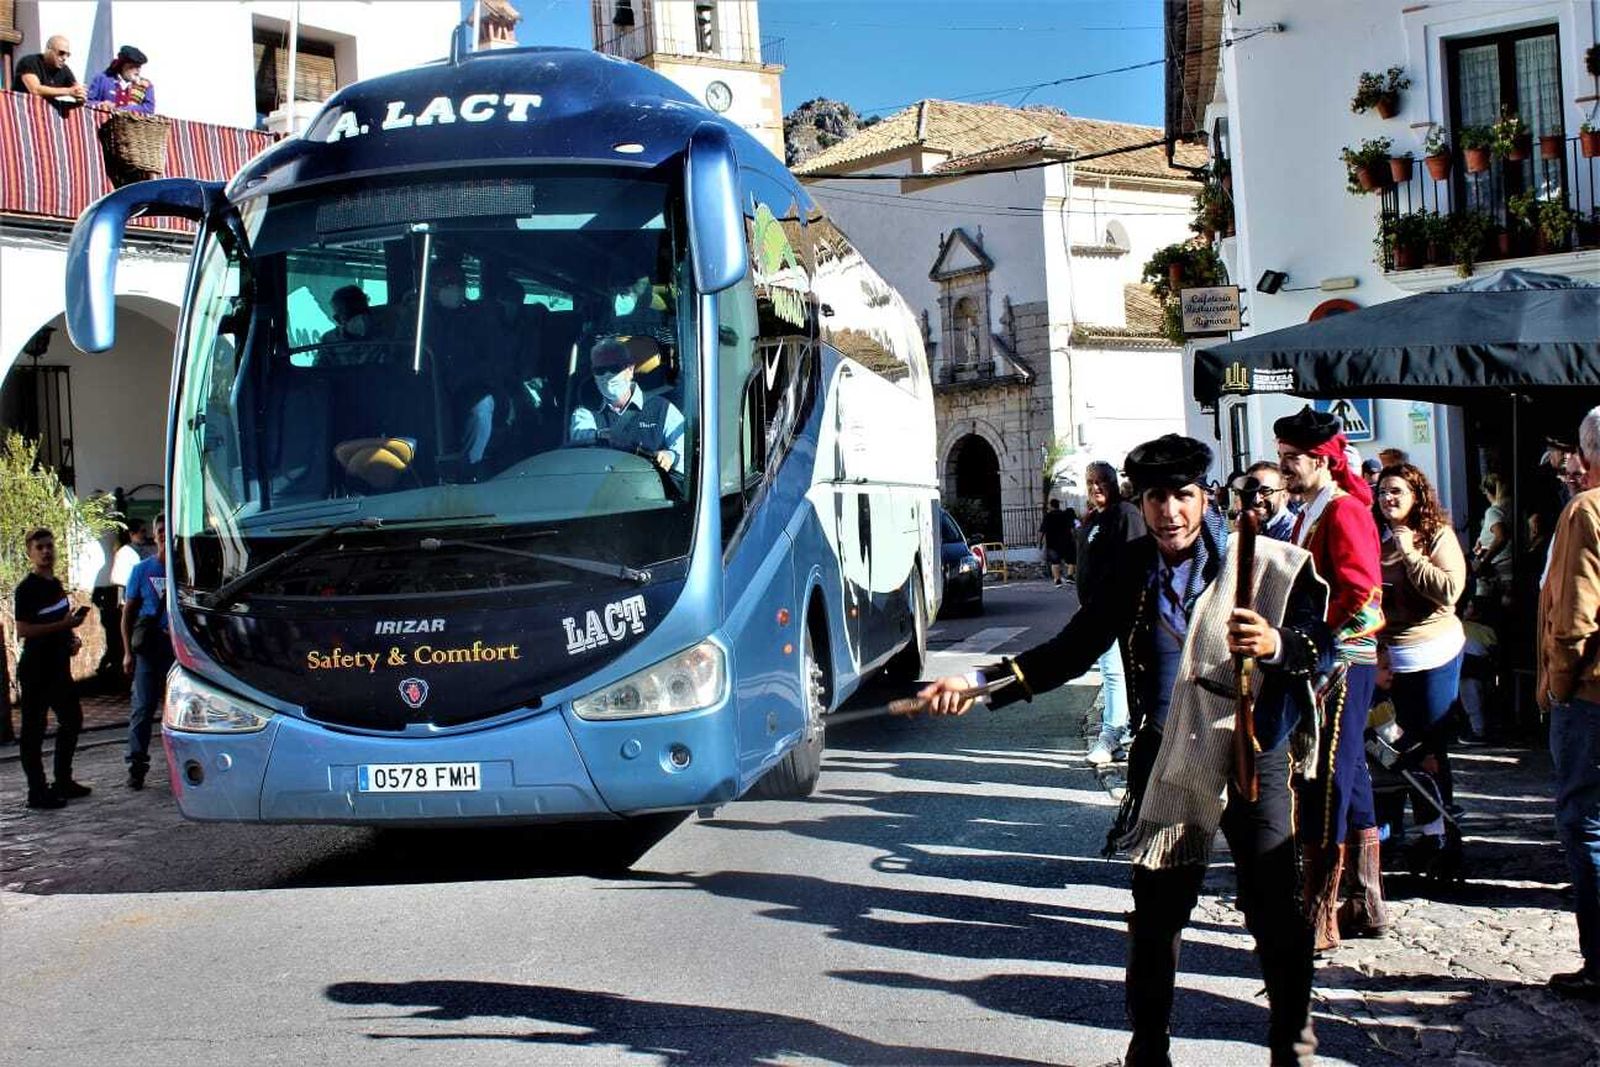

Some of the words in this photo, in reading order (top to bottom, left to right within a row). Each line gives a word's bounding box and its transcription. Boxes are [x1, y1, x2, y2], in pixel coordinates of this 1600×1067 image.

[326, 111, 369, 143] A.
[382, 94, 542, 130] LACT
[375, 619, 445, 634] IRIZAR
[562, 594, 646, 655] LACT
[307, 648, 380, 673] Safety
[388, 648, 407, 666] &
[414, 641, 523, 665] Comfort
[375, 768, 427, 788] 0578
[436, 766, 476, 787] FMH
